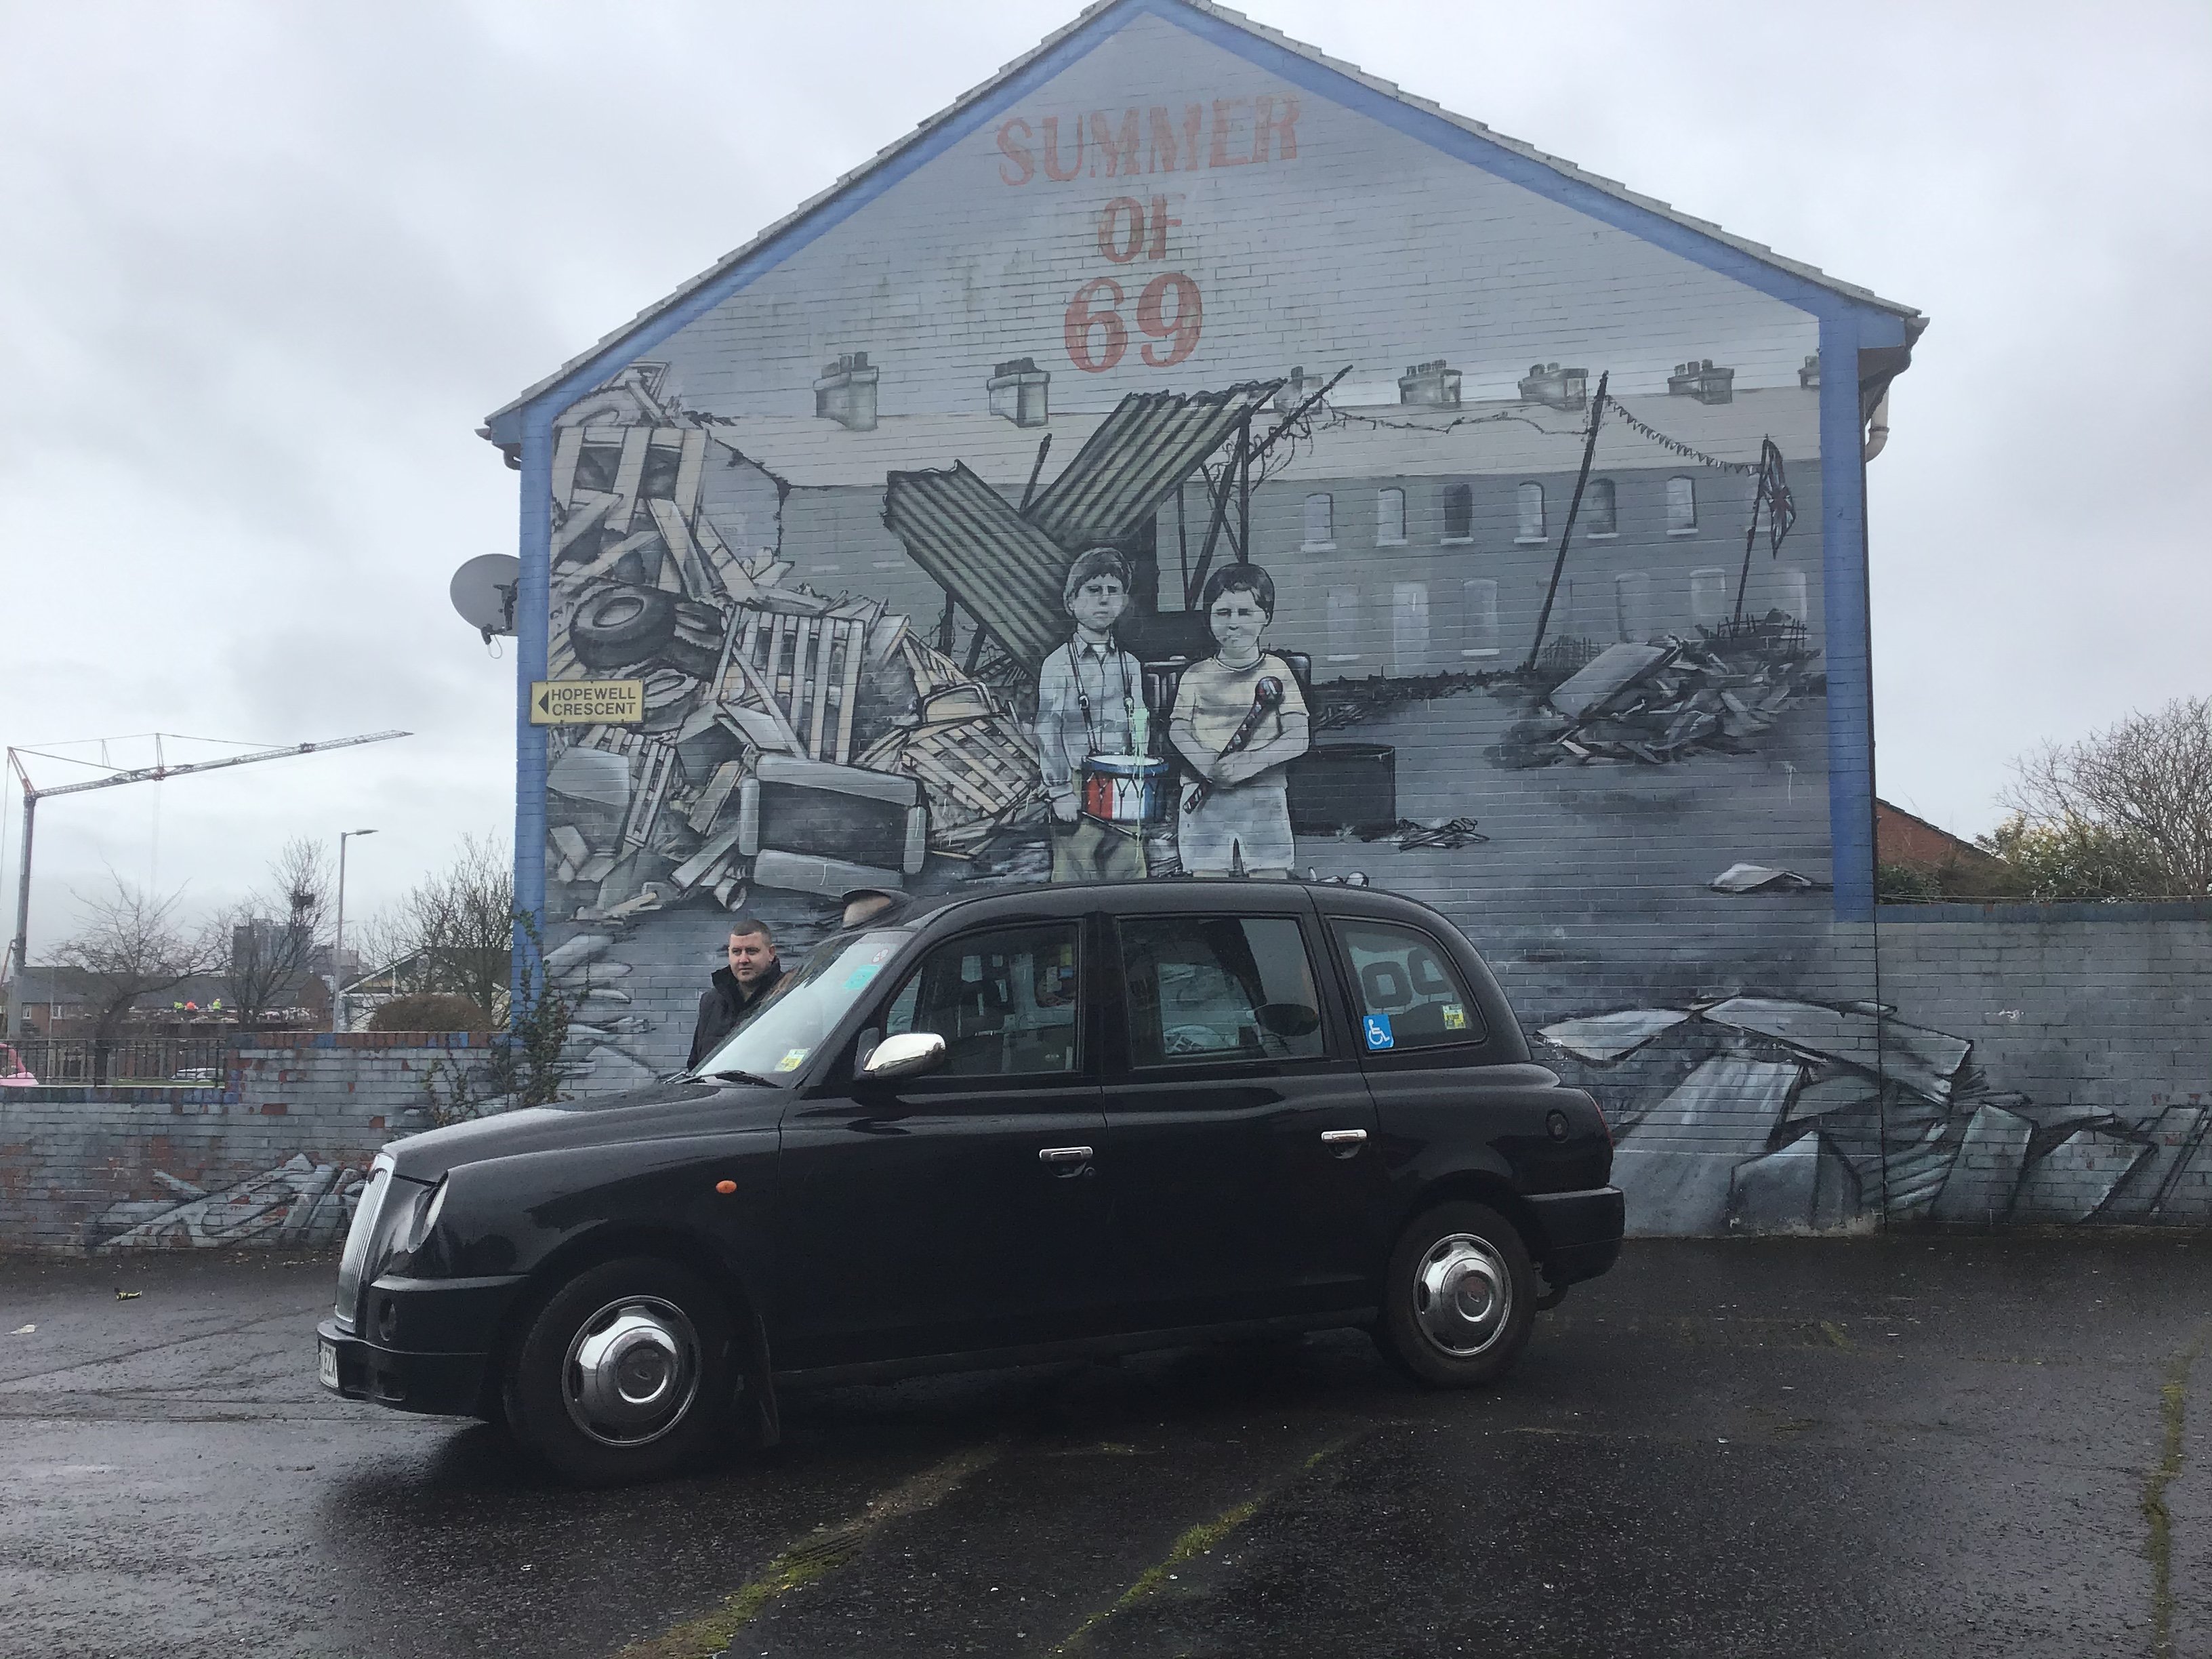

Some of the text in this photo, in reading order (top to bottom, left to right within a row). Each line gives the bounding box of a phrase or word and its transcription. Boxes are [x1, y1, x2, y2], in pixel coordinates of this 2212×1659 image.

[996, 94, 1300, 186] SUMMER
[1098, 193, 1186, 263] OF
[1064, 272, 1203, 373] 69
[551, 687, 636, 701] HOPEWELL
[552, 702, 636, 716] CRESCENT
